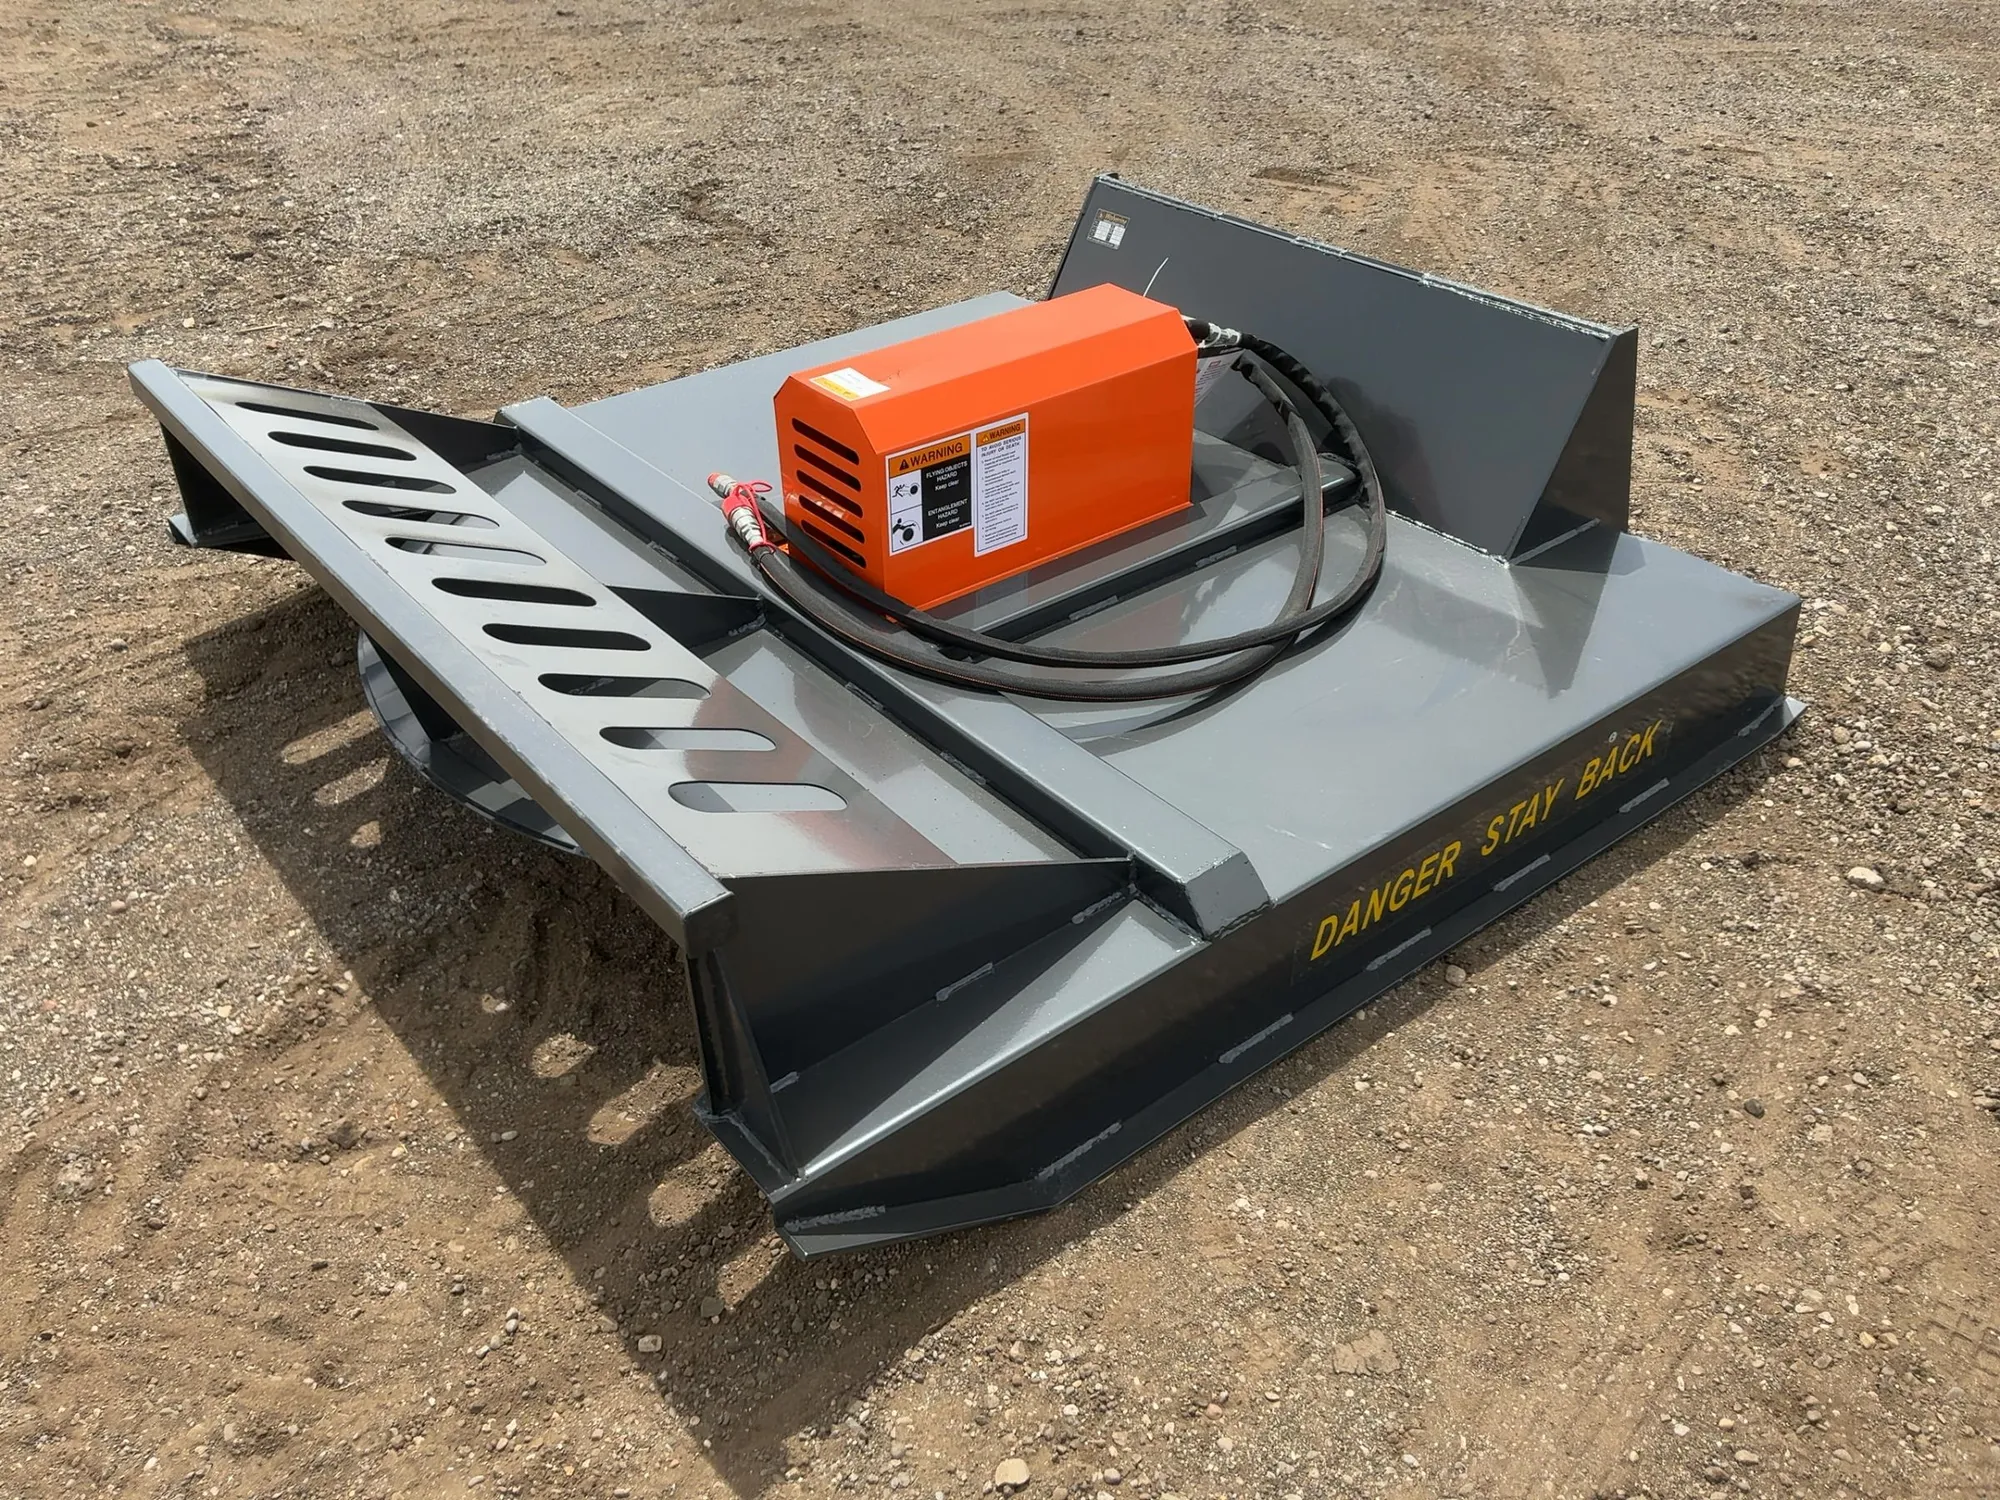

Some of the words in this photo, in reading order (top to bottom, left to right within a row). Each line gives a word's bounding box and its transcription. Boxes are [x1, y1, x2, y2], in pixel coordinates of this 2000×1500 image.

[990, 423, 1021, 440] WARNING
[910, 442, 963, 468] WARNING
[926, 468, 945, 479] FLYING
[944, 460, 968, 474] OBJECTS
[936, 470, 958, 482] HAZARD
[935, 483, 948, 492] Keep
[948, 479, 960, 488] clear
[927, 498, 968, 517] ENTANGLEMENT
[937, 508, 959, 520] HAZARD
[935, 520, 948, 529] Keep
[948, 516, 960, 525] clear
[1310, 840, 1462, 962] DANGER
[1481, 777, 1565, 857] STAY
[1574, 719, 1664, 801] BACK
